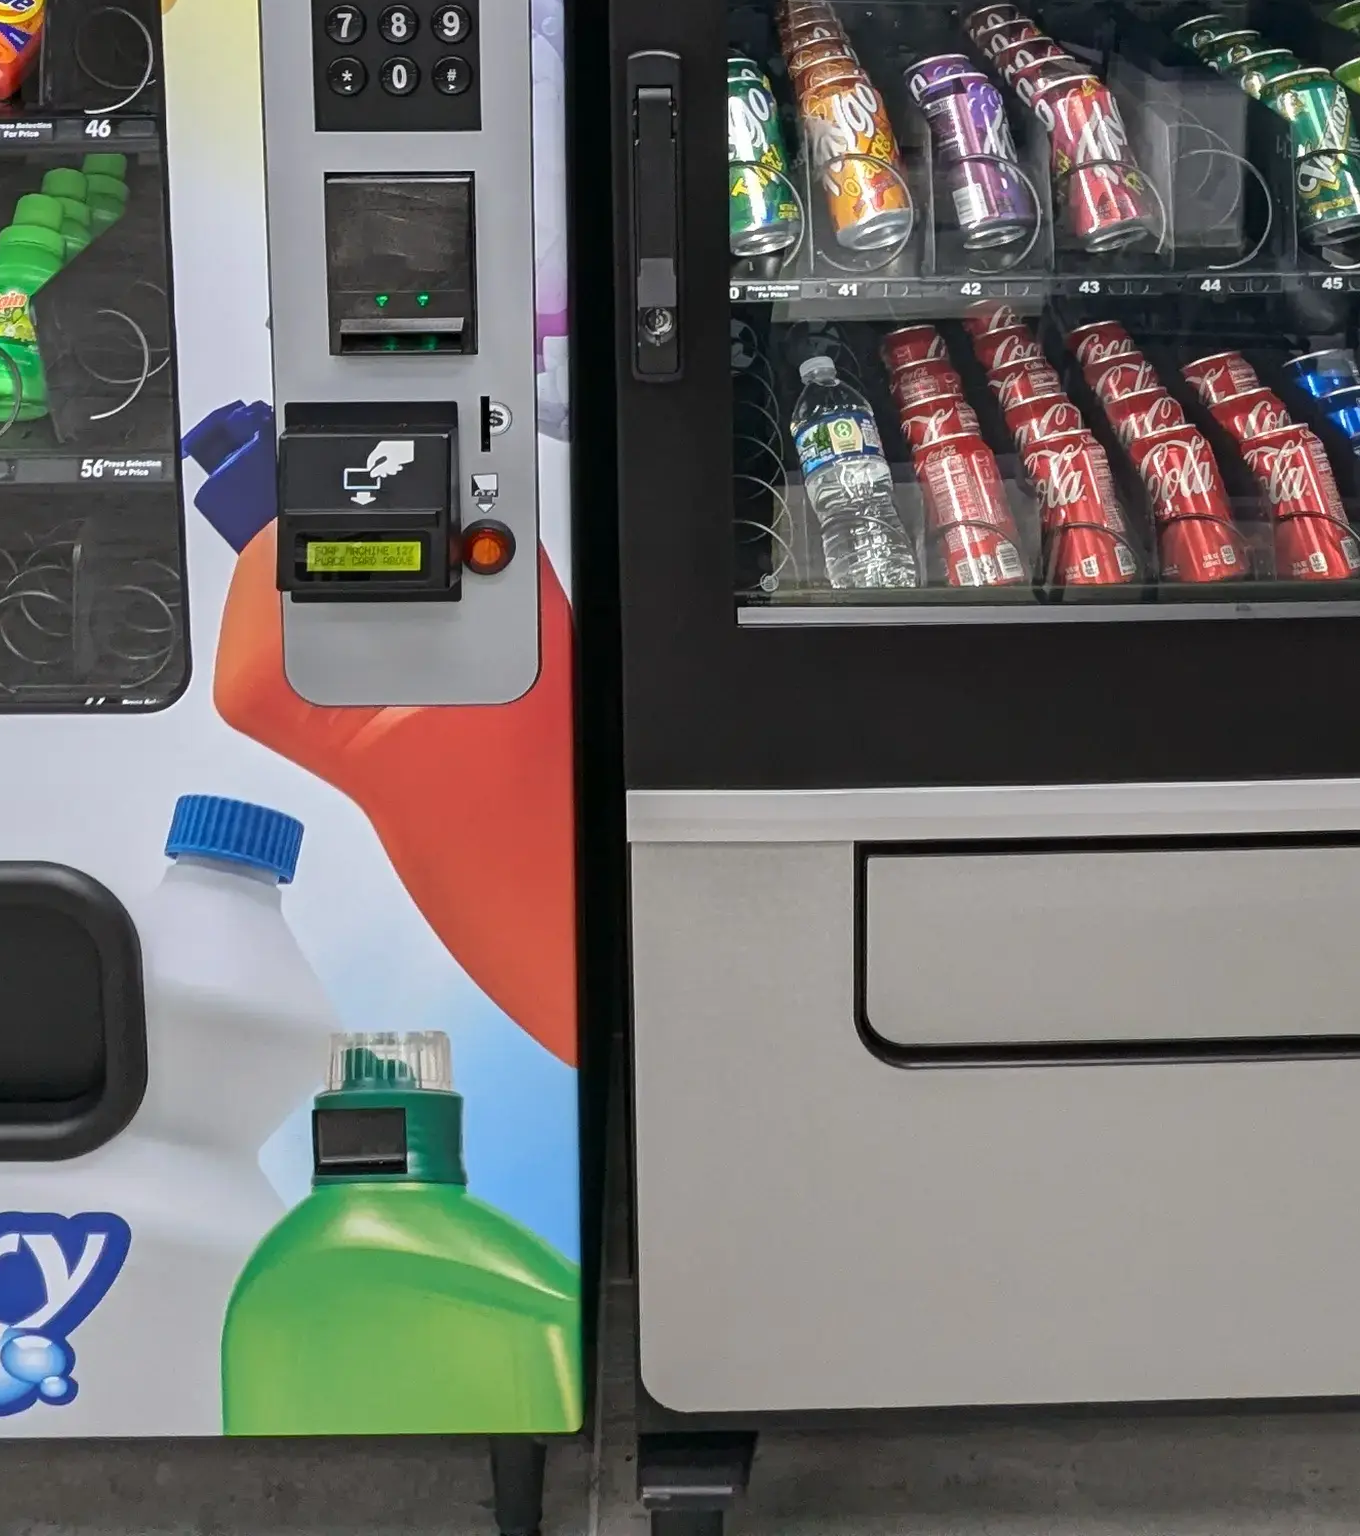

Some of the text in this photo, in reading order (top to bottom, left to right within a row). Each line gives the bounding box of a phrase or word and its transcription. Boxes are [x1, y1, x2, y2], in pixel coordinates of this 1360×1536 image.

[337, 12, 460, 37] 7 8 9
[392, 65, 408, 89] 0
[85, 120, 110, 137] 46
[961, 283, 981, 295] 42
[1079, 281, 1100, 293] 43
[1200, 280, 1221, 292] 44
[1322, 278, 1343, 289] 45
[839, 284, 857, 296] 41
[81, 460, 103, 478] 56
